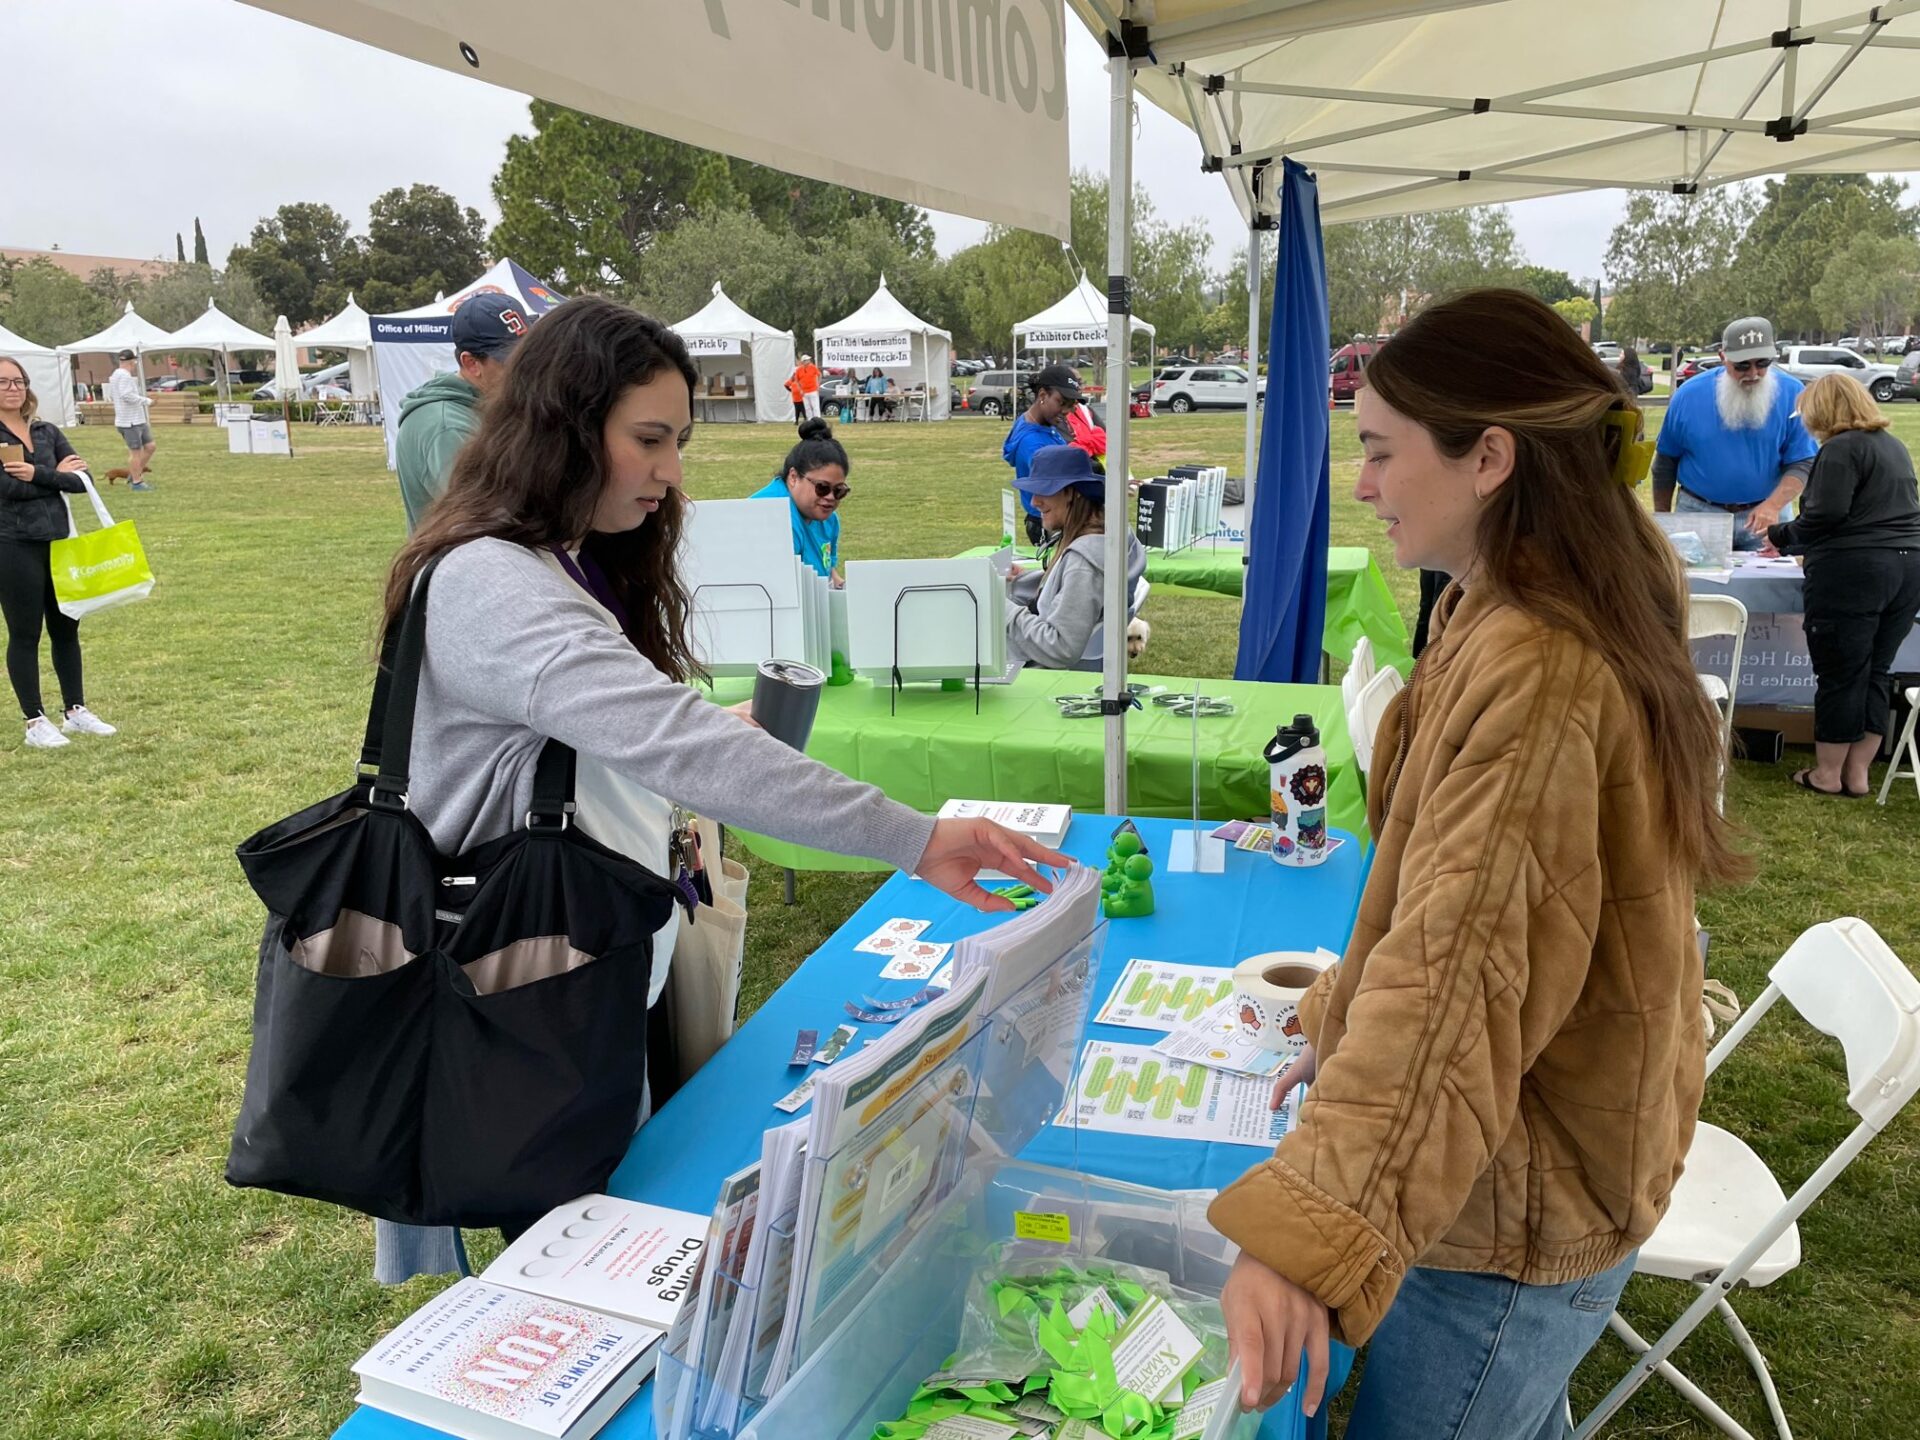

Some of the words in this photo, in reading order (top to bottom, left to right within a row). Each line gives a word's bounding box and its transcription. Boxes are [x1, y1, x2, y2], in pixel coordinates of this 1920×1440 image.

[377, 323, 402, 333] Office
[404, 324, 413, 333] of
[415, 324, 448, 335] Military
[1030, 331, 1071, 341] Exhibitor
[1073, 330, 1108, 340] Check-I
[699, 339, 716, 349] Pick
[718, 338, 728, 351] Up
[827, 353, 868, 362] Volunteer
[870, 352, 908, 362] Check-In
[647, 1238, 703, 1286] Drugs
[427, 1287, 487, 1334] Catherine
[455, 1315, 479, 1330] FEEL
[431, 1331, 459, 1350] ALIVE
[591, 1332, 623, 1352] THE
[385, 1336, 425, 1367] Price
[404, 1351, 435, 1373] AGAIN
[460, 1314, 581, 1392] FUN
[553, 1353, 600, 1389] POWER
[1128, 1353, 1163, 1392] MATTE
[1141, 1365, 1172, 1397] EachM
[538, 1391, 561, 1407] OF
